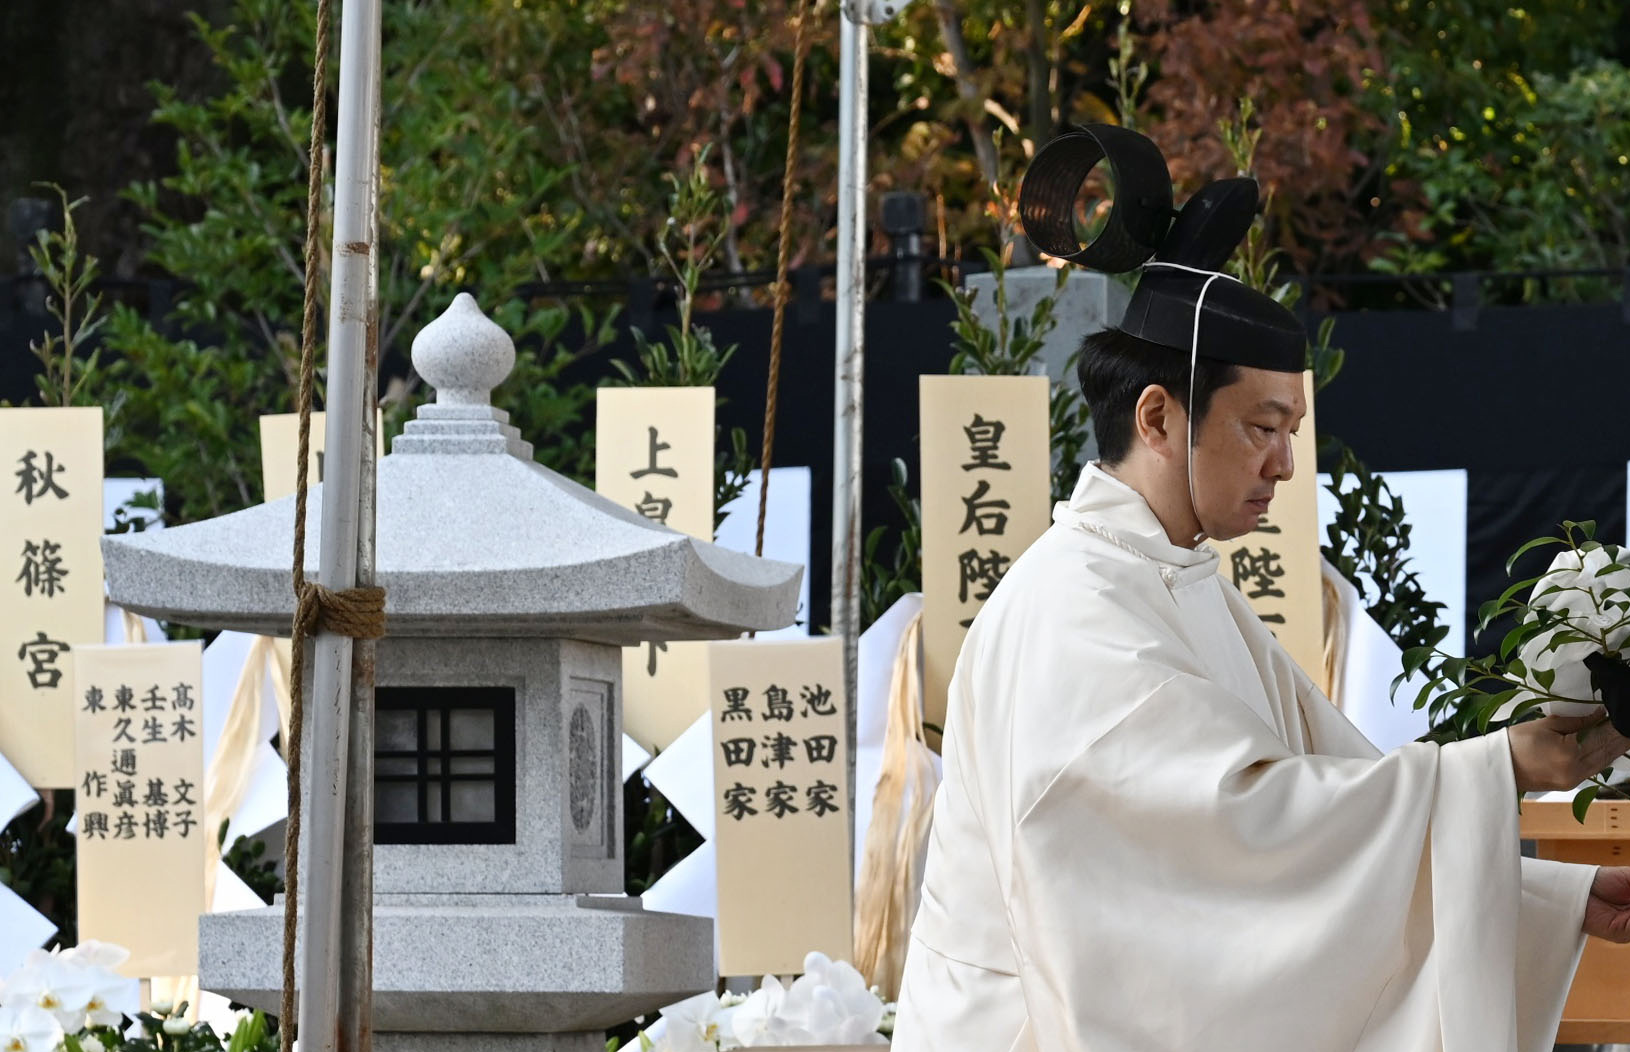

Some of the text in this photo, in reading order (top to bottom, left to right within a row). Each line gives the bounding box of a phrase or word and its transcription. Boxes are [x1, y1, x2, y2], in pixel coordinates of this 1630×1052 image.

[14, 449, 71, 690] 秋篠宮
[958, 413, 1012, 629] 皇后陛
[140, 684, 170, 840] 壬生 基博
[172, 778, 198, 838] 文子
[720, 686, 759, 822] 黒田家
[760, 683, 799, 819] 島津家
[799, 683, 840, 818] 池田家
